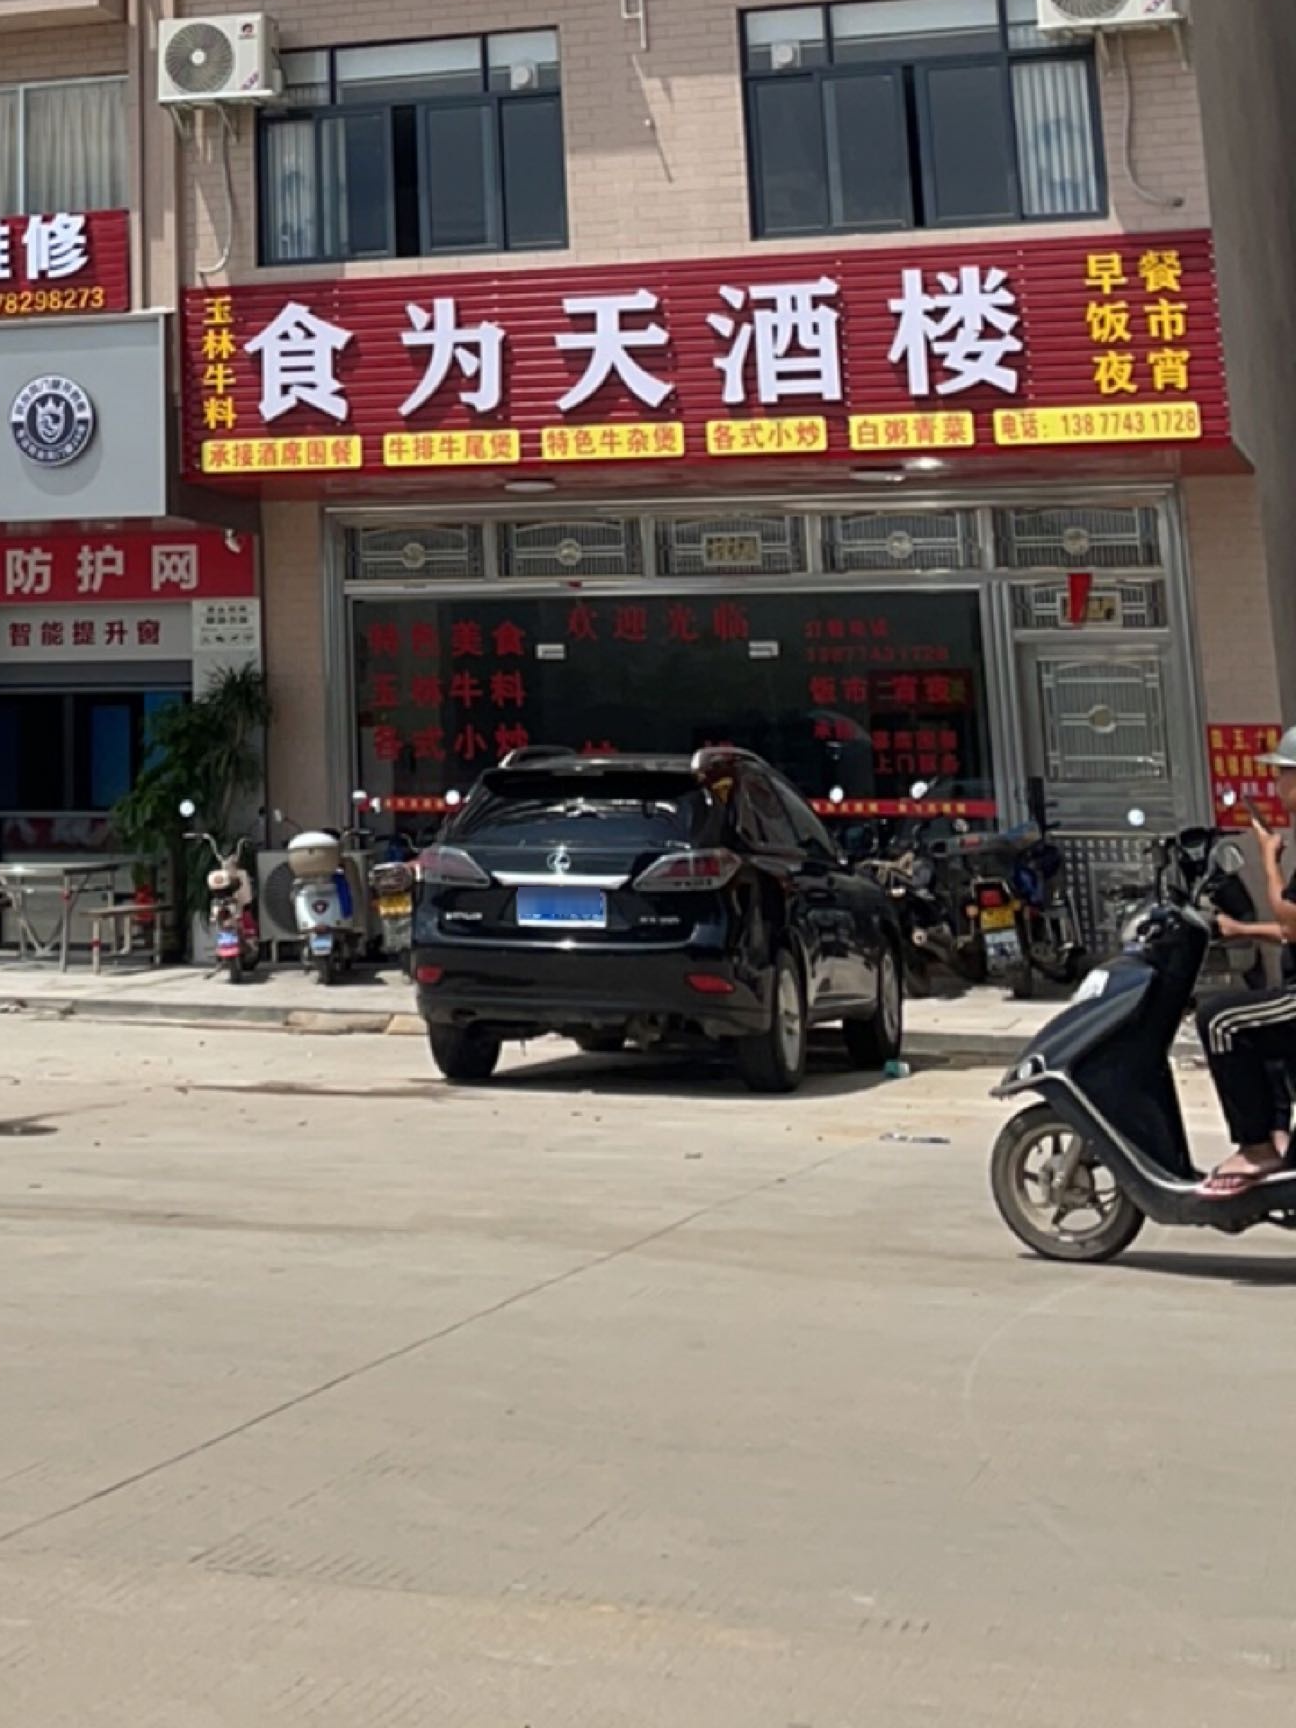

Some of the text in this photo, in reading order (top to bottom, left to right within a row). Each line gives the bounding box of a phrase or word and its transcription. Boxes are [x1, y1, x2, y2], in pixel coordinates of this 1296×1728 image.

[1085, 250, 1183, 294] 早餐
[1085, 298, 1188, 343] 饭市
[203, 295, 236, 430] 玉林牛料
[244, 265, 1024, 423] 食为天酒楼
[1092, 349, 1191, 395] 夜宵
[388, 432, 514, 461] 牛排牛尾煲
[546, 425, 678, 456] 特色牛杂煲
[711, 422, 821, 452] 各式小炒
[856, 414, 969, 444] 白粥青菜
[9, 618, 161, 648] 智能提升窗
